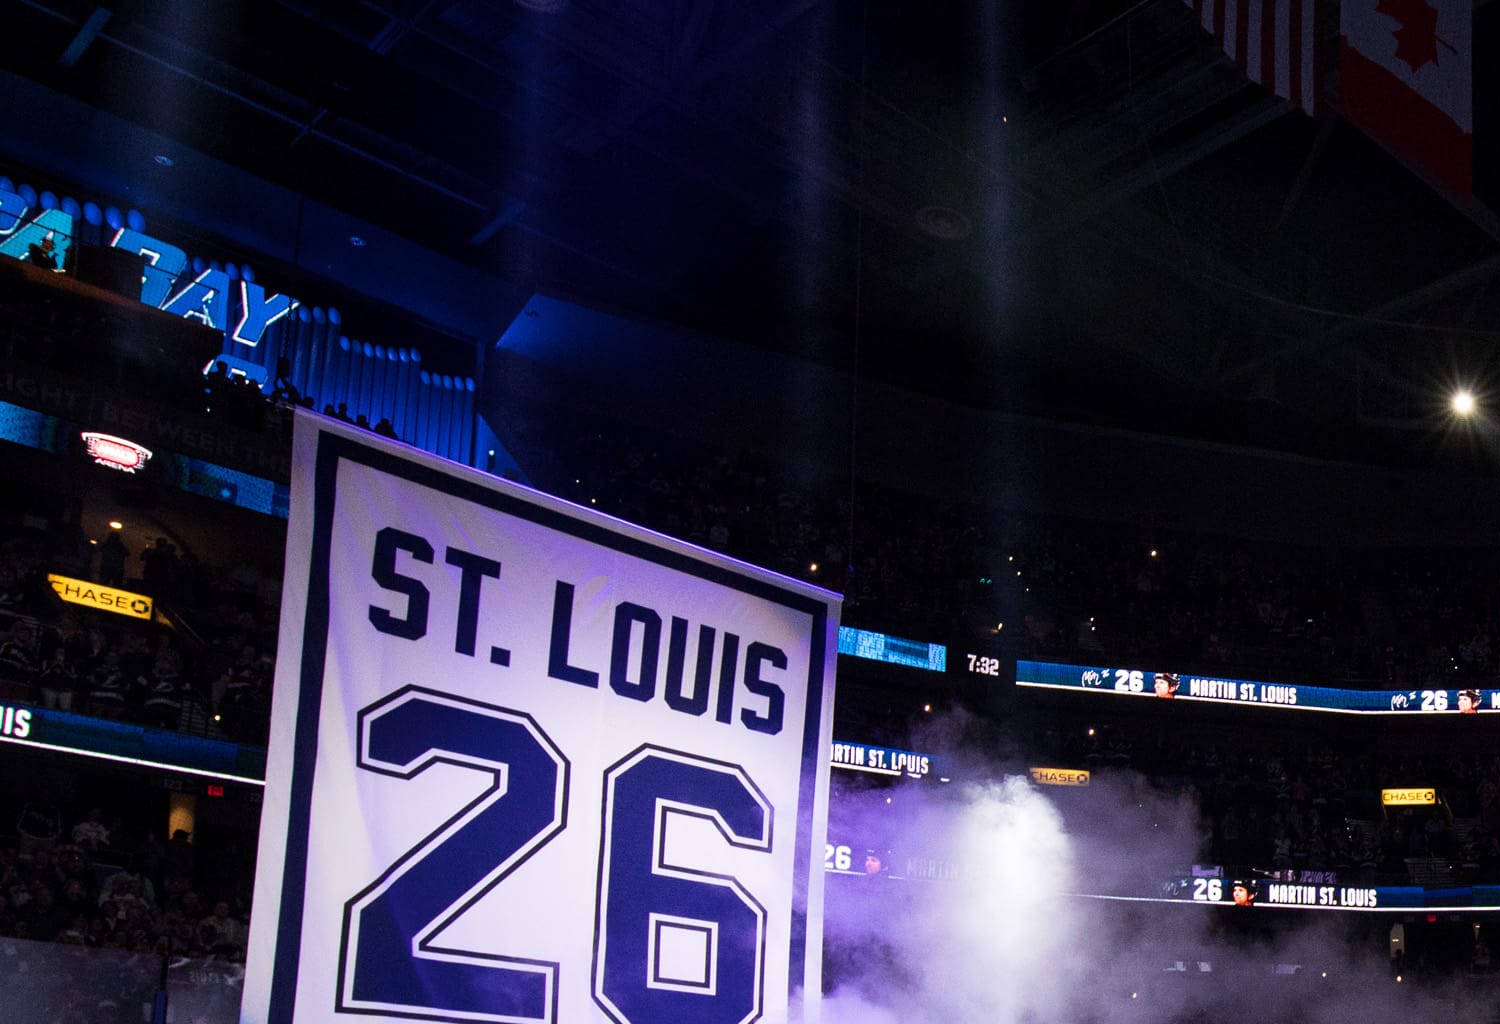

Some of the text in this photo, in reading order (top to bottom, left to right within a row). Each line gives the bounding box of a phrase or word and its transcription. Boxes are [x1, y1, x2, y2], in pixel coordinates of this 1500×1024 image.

[51, 581, 128, 609] CHASE
[369, 526, 789, 736] ST. LOUIS
[967, 653, 1000, 677] 7:32
[1114, 669, 1144, 692] 26
[1190, 678, 1236, 699] MARTIN
[1240, 683, 1258, 701] ST.
[1261, 685, 1297, 705] LOUIS
[1421, 690, 1448, 711] 26
[0, 703, 32, 737] IS
[868, 749, 887, 769] ST.
[1031, 772, 1076, 783] CHASE
[1383, 792, 1423, 801] CHASE
[1193, 878, 1223, 902] 26
[1268, 884, 1316, 906] MARTIN
[1319, 886, 1338, 906] ST.
[1340, 888, 1377, 908] LOUIS
